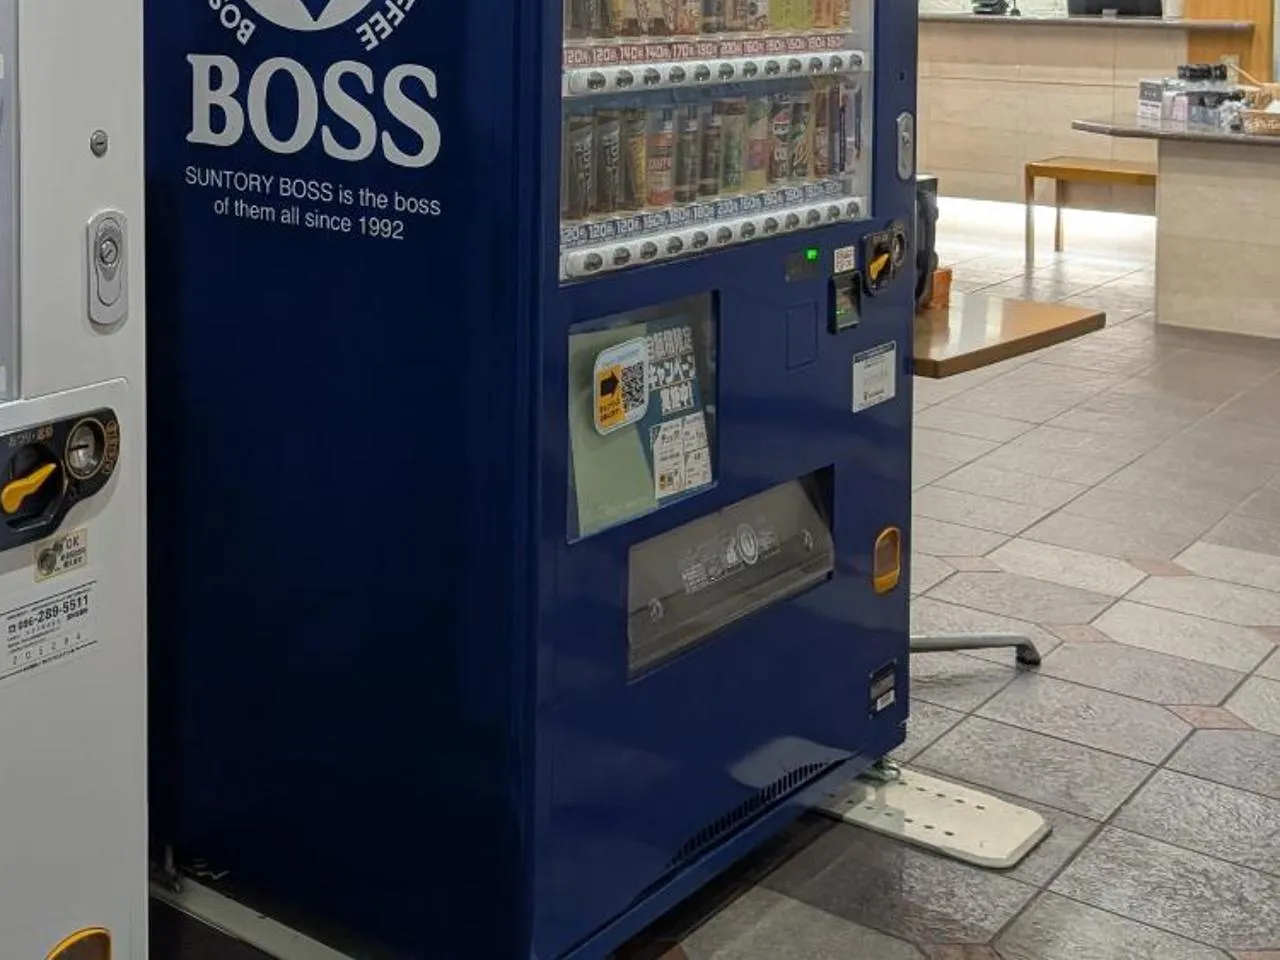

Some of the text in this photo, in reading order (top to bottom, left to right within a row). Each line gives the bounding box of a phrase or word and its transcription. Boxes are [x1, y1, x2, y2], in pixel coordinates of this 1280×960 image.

[185, 53, 441, 168] BOSS
[185, 165, 442, 216] SUNTORY BOSS is the boss
[213, 198, 405, 240] of them all since 1992
